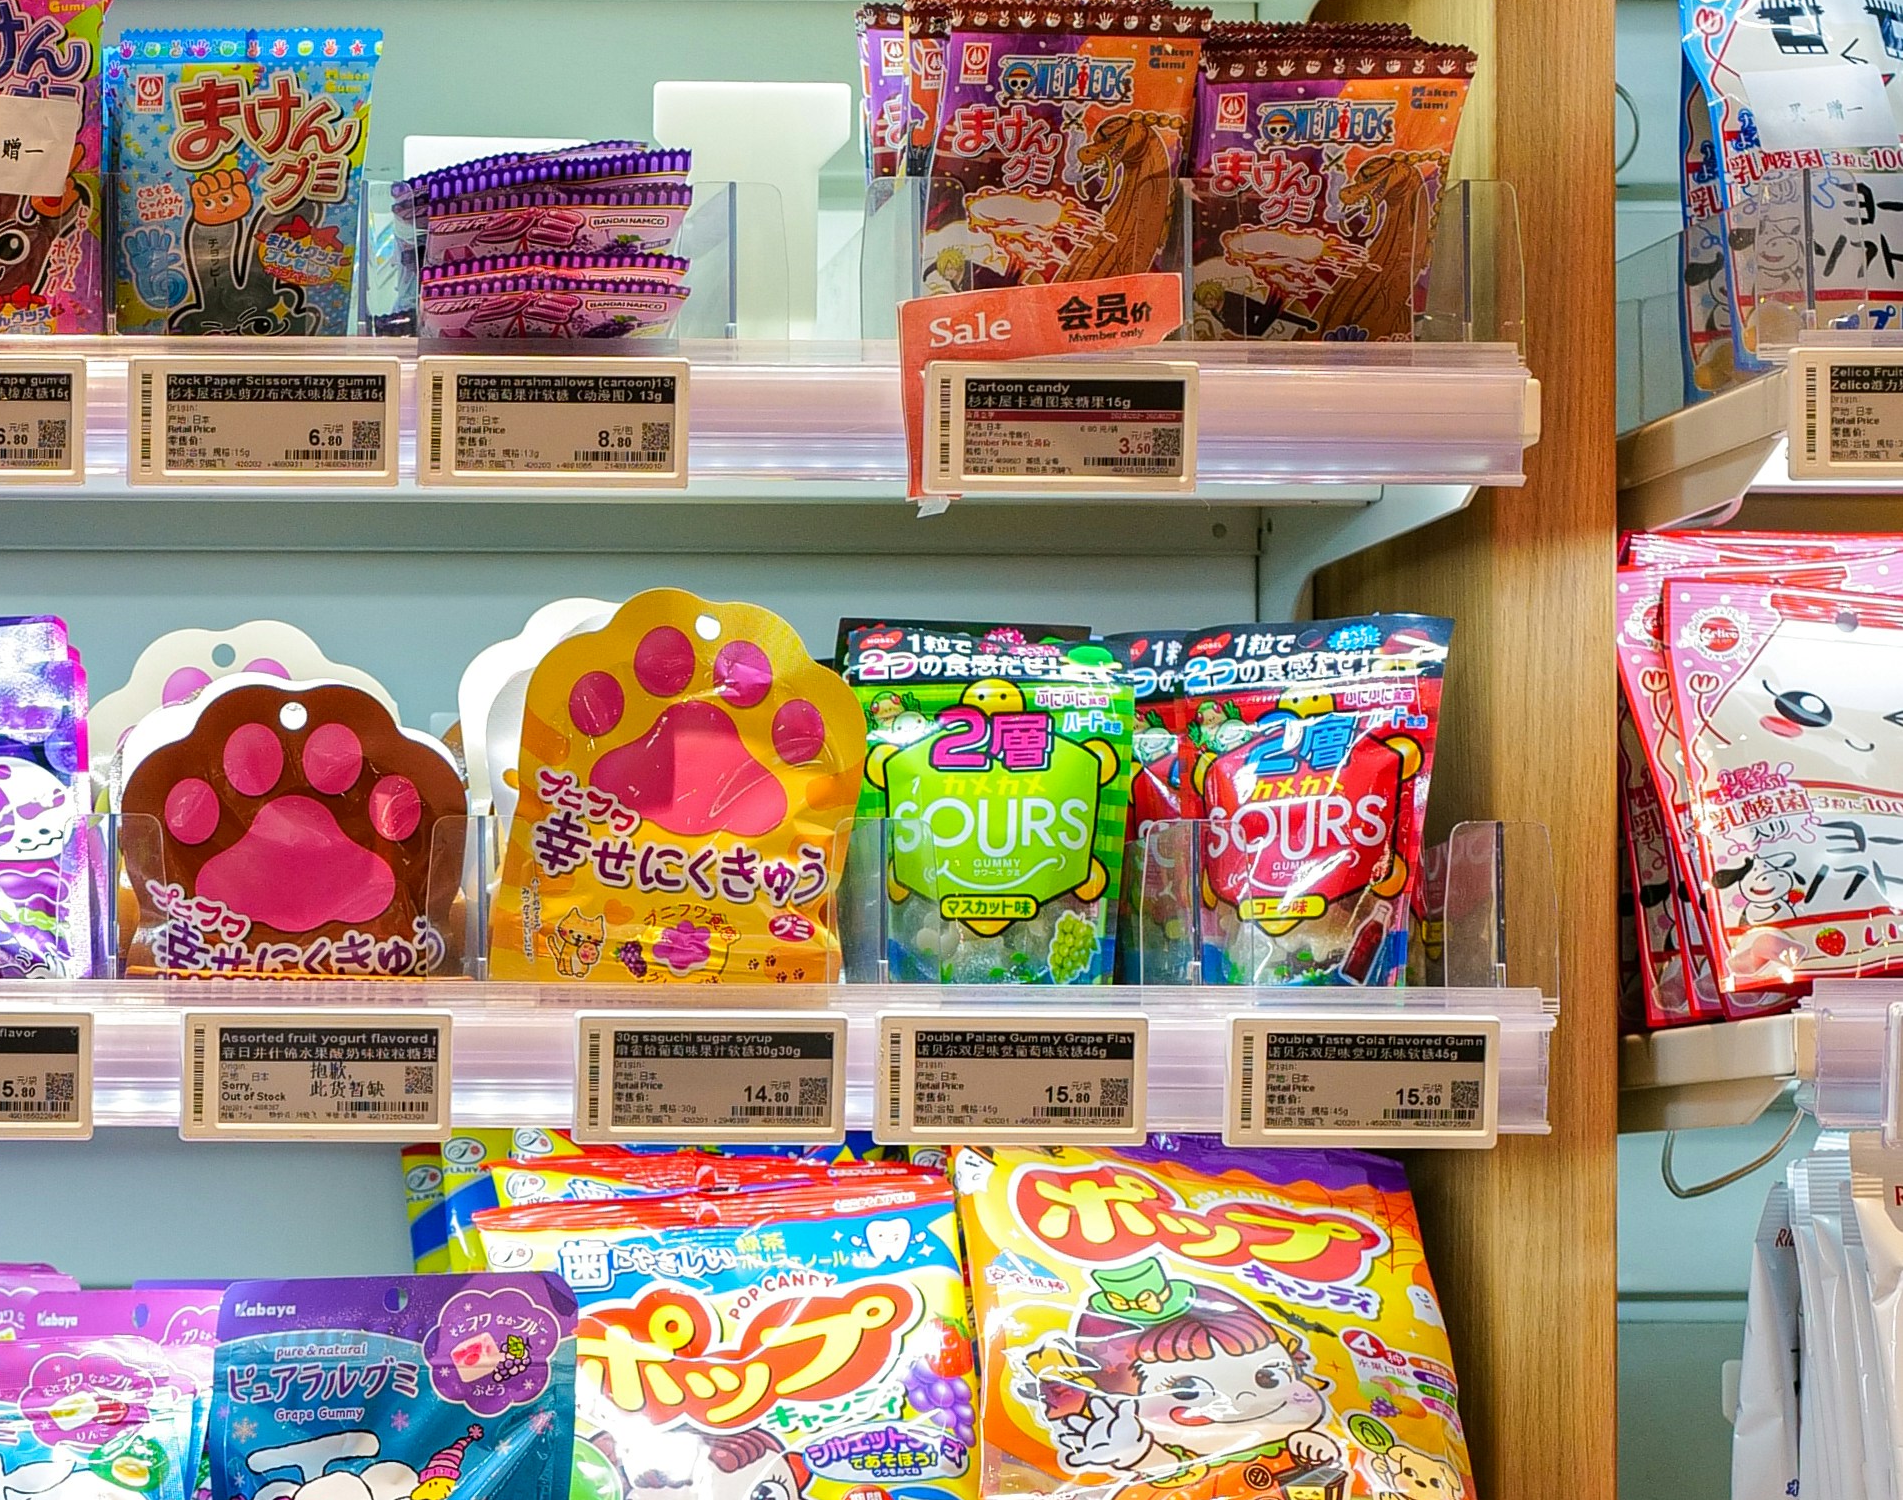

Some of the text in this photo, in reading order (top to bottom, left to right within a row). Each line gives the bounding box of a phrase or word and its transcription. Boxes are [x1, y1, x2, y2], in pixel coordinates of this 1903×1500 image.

[176, 74, 356, 169] まけん
[594, 215, 665, 227] BANDAI NAMCO
[929, 311, 1011, 348] Sale
[1056, 296, 1153, 332] 会员价
[1118, 437, 1152, 455] 3.50
[931, 708, 1053, 770] 2層
[895, 797, 1089, 851] SOURS
[533, 812, 828, 901] 幸せにくきゅう
[945, 900, 1033, 918] マスカット味
[1036, 1174, 1370, 1267] ポップ
[235, 1301, 297, 1318] Kabaya
[1243, 1263, 1383, 1319] キャンディ
[228, 1361, 418, 1404] ピュアラルグミ
[276, 1406, 365, 1423] Grape Gummy
